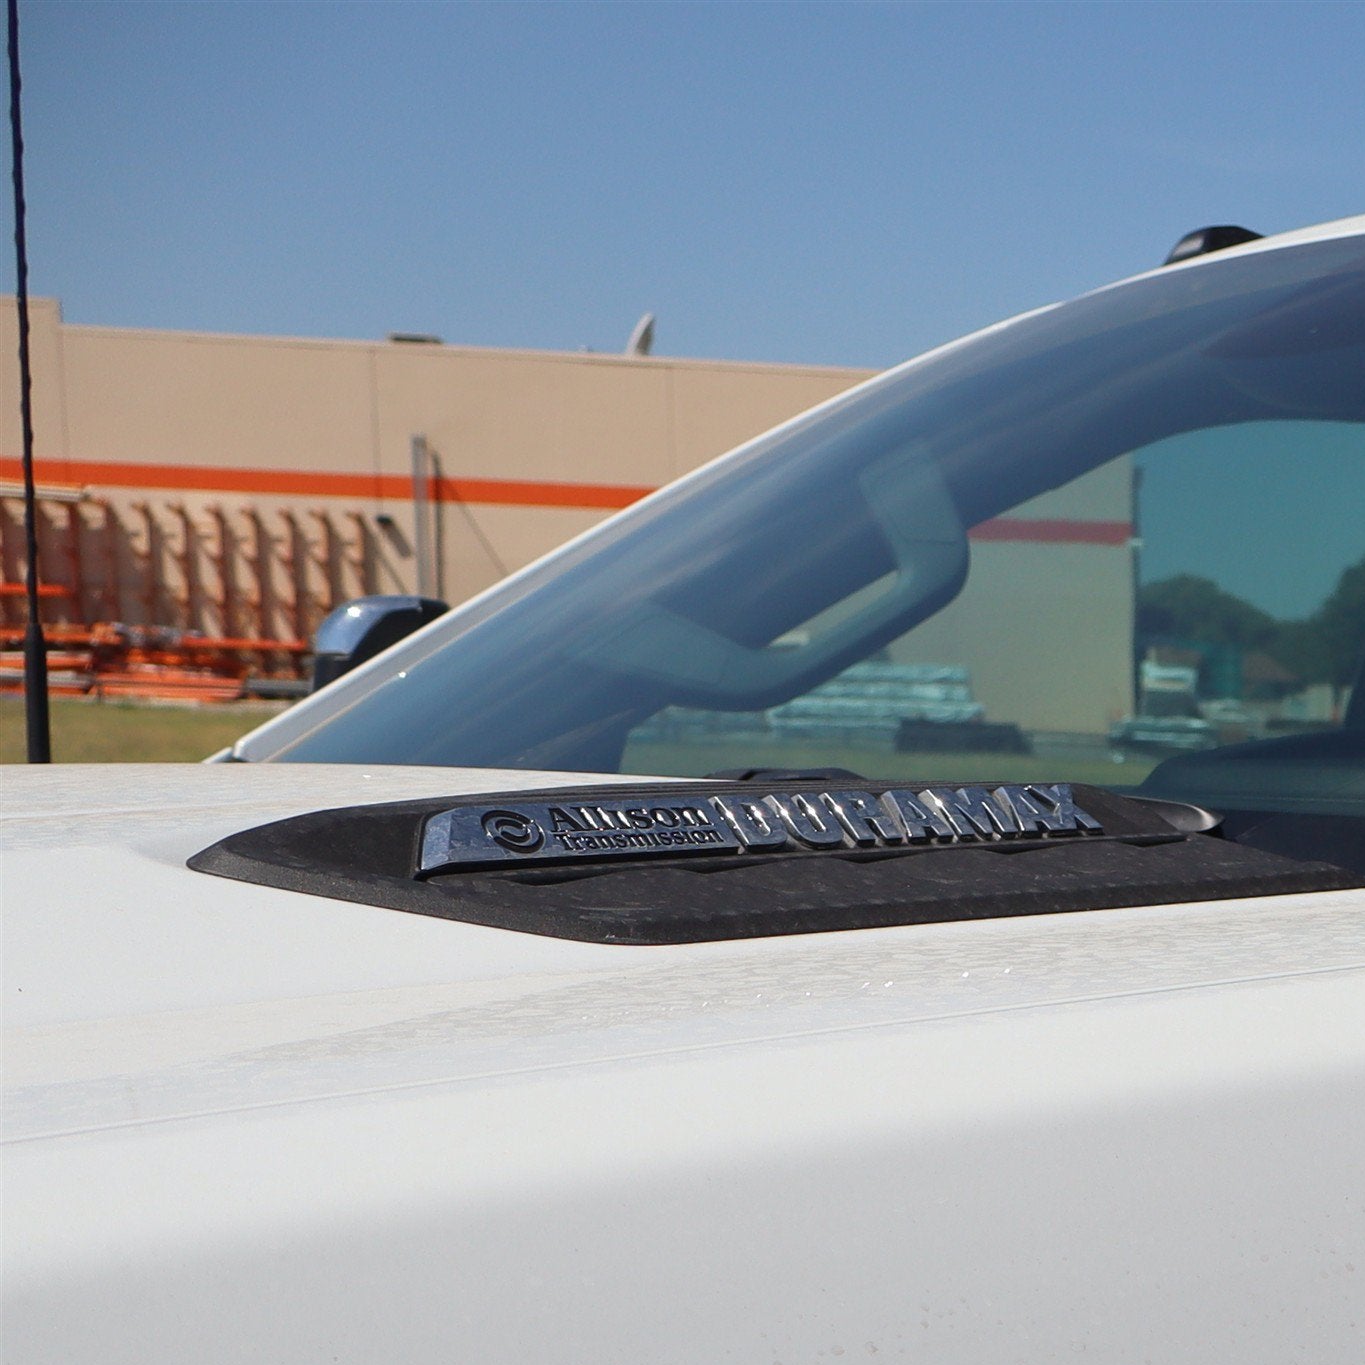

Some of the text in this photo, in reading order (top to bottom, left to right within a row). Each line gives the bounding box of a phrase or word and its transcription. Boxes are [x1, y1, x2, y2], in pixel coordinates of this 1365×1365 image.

[550, 806, 715, 832] Allison
[707, 783, 1105, 856] DURAMAX
[555, 826, 725, 851] Transmission
